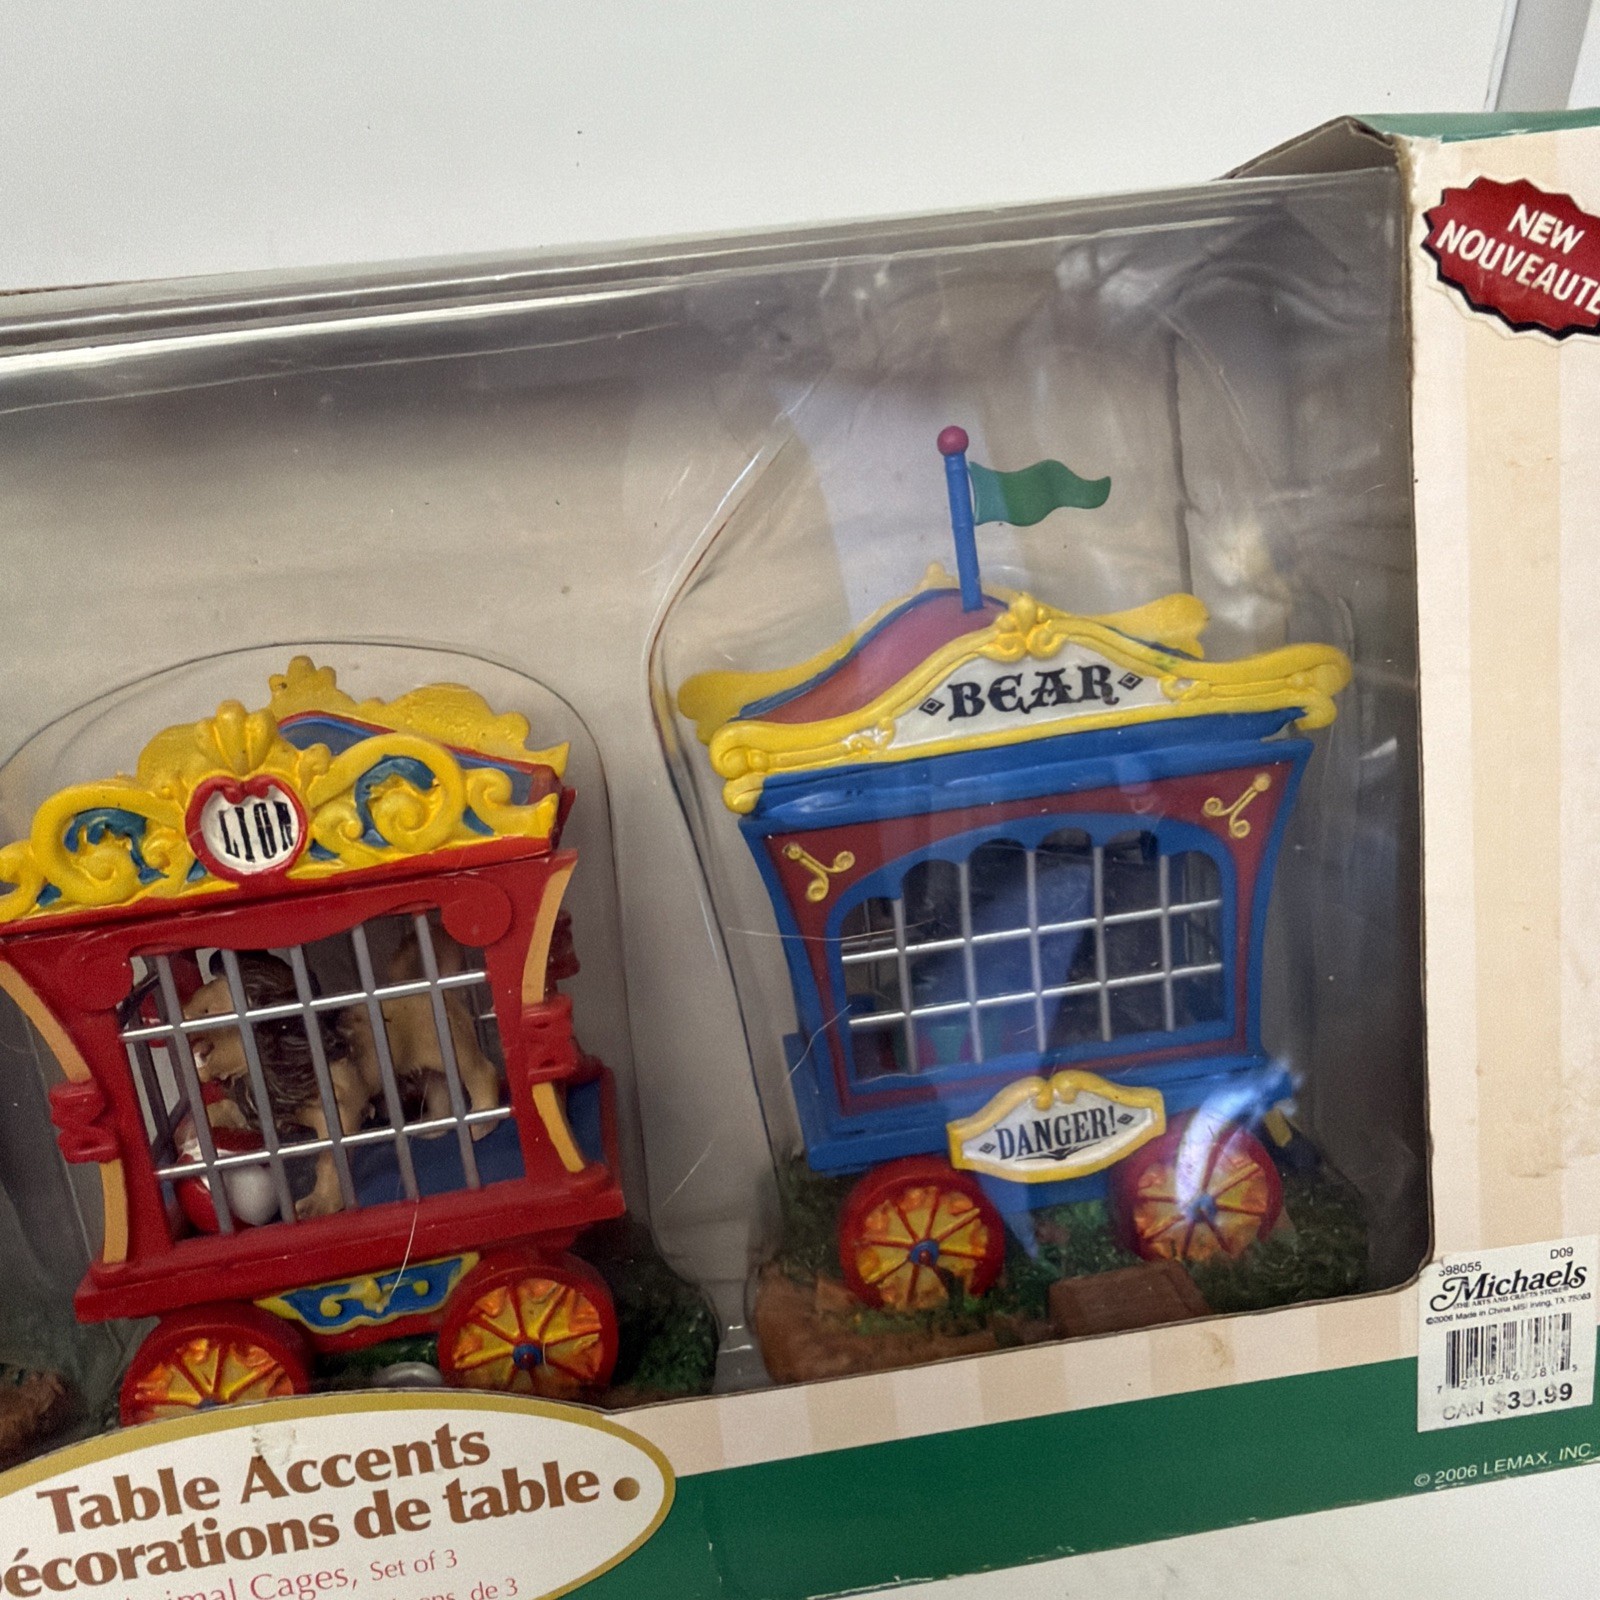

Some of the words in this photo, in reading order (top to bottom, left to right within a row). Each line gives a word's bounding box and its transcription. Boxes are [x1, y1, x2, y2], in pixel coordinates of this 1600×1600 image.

[1507, 203, 1585, 255] NEW
[948, 664, 1120, 722] BEAR
[996, 1105, 1117, 1160] DANGER!
[1550, 1246, 1574, 1260] D09
[1430, 1260, 1587, 1312] Michaels
[36, 1467, 220, 1535] Table
[240, 1423, 490, 1504] Accents
[1434, 1465, 1477, 1484] 2006
[0, 1513, 340, 1597] écorations
[354, 1489, 431, 1539] de
[442, 1460, 600, 1524] table
[250, 1566, 357, 1600] Cages,
[370, 1560, 405, 1581] Set
[414, 1550, 436, 1573] of
[445, 1549, 458, 1569] 3
[471, 1581, 498, 1600] de
[505, 1578, 518, 1597] 3
